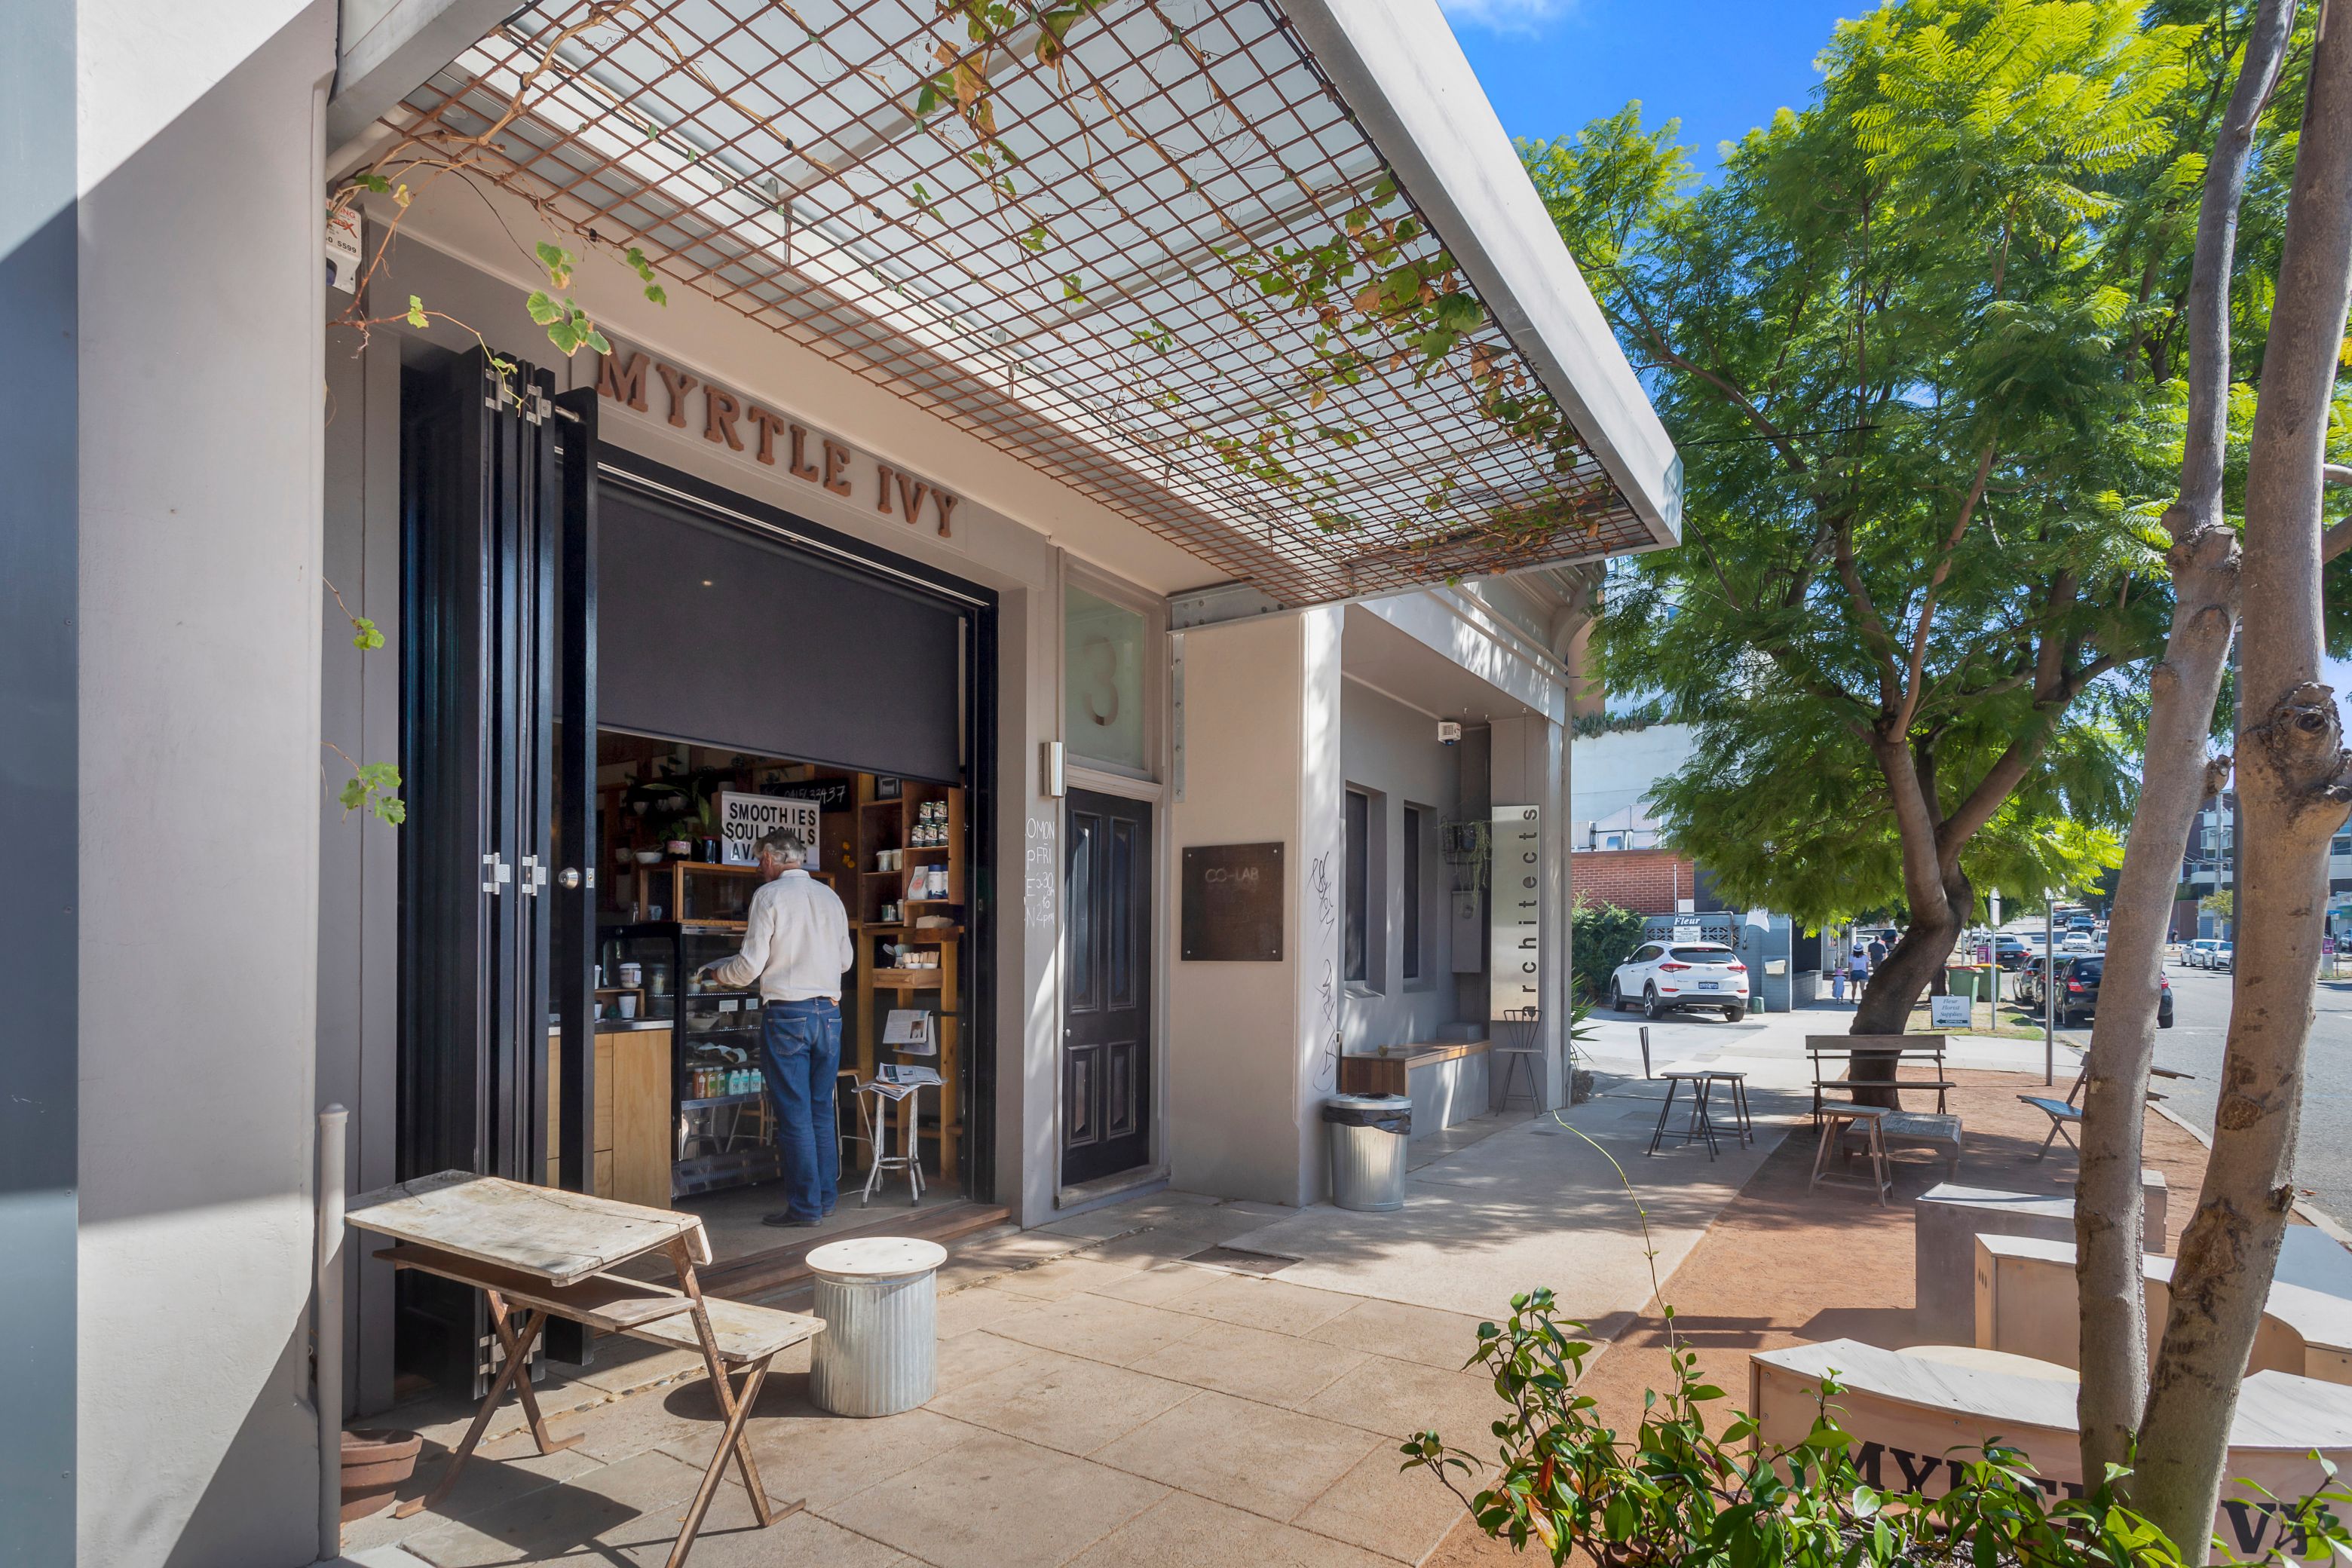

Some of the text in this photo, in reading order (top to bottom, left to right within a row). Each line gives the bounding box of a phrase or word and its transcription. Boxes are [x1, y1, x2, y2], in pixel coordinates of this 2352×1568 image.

[337, 240, 357, 253] 5599
[595, 339, 959, 538] MYRTLE IVY
[1083, 634, 1119, 727] 3
[729, 802, 816, 826] SMOOTHIES
[726, 822, 761, 841] SOUL
[1036, 820, 1055, 840] MON
[1037, 846, 1052, 865] FRI
[1518, 808, 1538, 1018] architects
[1674, 917, 1701, 925] Fleur
